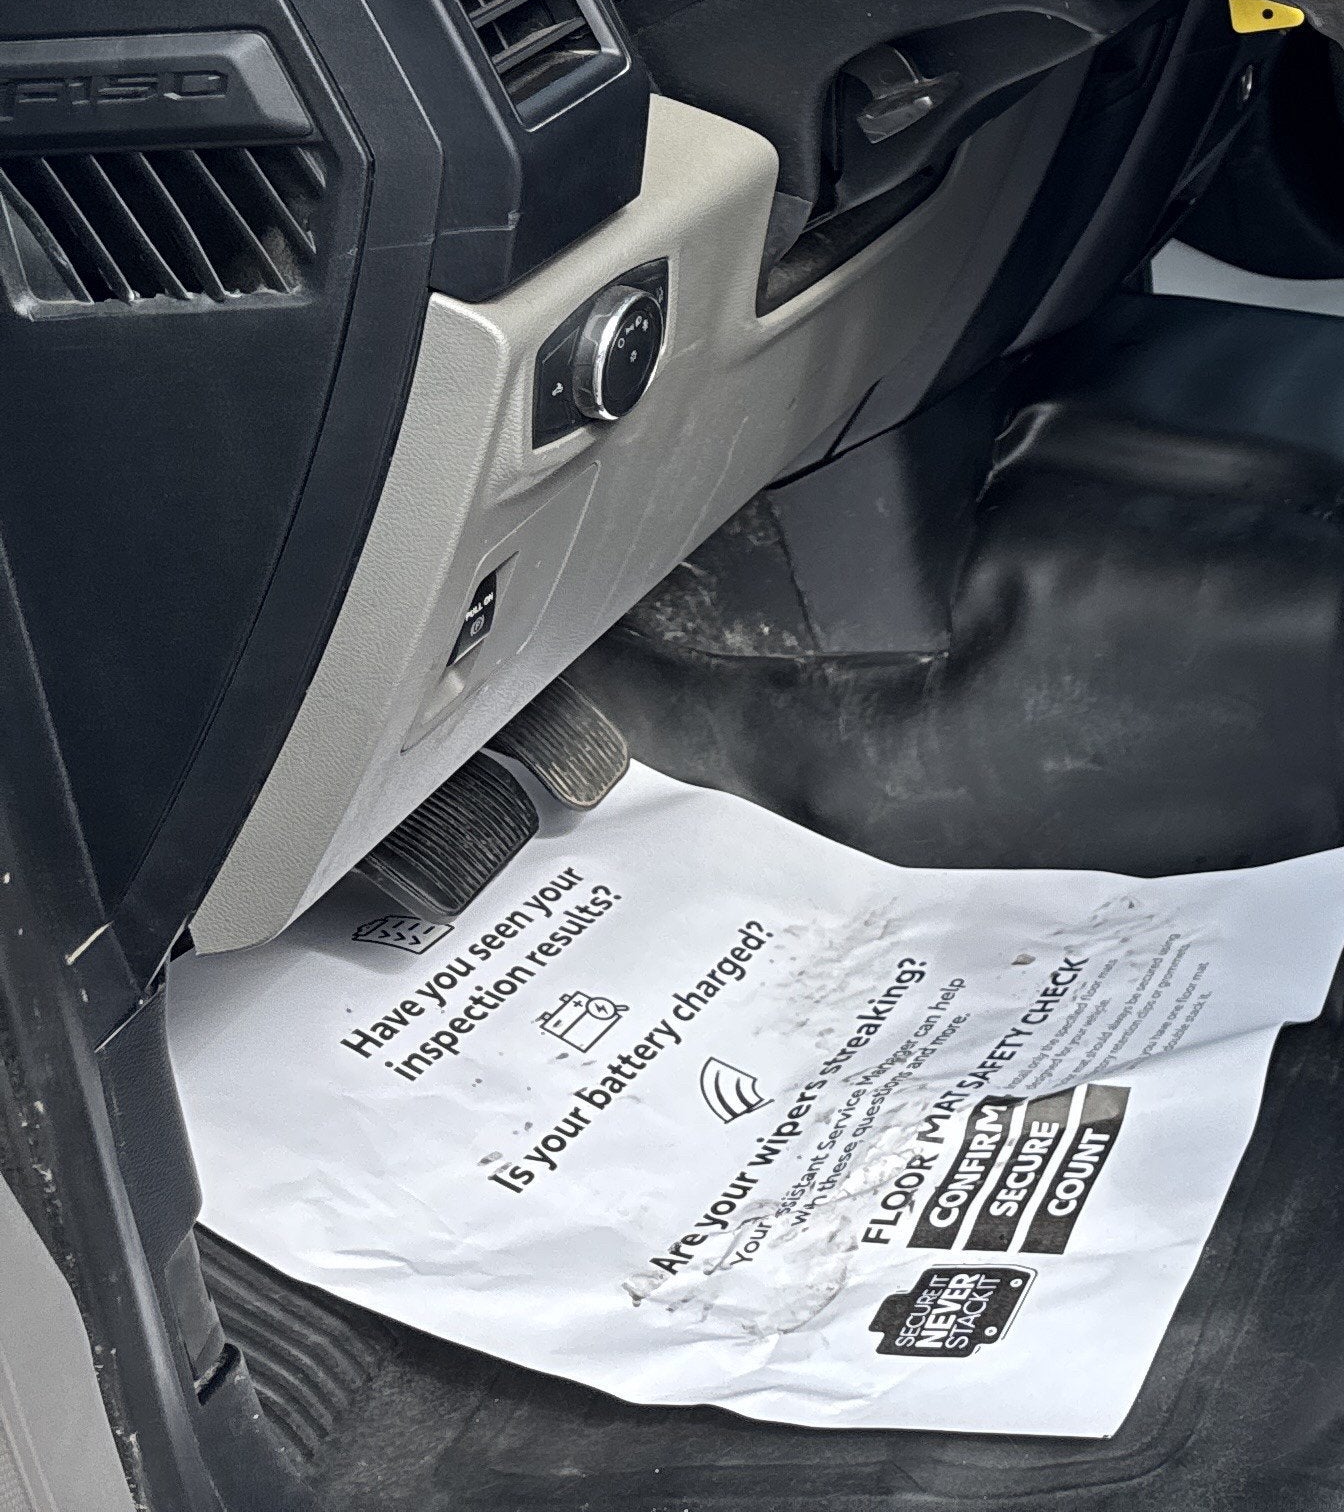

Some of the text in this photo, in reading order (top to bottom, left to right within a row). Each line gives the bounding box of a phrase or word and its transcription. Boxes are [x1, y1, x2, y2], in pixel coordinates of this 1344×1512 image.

[340, 867, 584, 1059] Have you seen your
[384, 885, 622, 1082] inspection results?
[927, 978, 966, 1011] help
[488, 920, 774, 1194] Is your battery charged?
[914, 1014, 941, 1038] can
[649, 957, 927, 1275] Are your wipers streaking?
[817, 1088, 867, 1151] Service
[818, 1142, 858, 1192] these
[852, 1071, 913, 1138] questions
[906, 1047, 937, 1069] and
[861, 957, 1089, 1244] FLOOR MAT SAFETY CHECK
[775, 1153, 829, 1218] ssistant
[929, 1104, 1007, 1228] CONFIRM
[989, 1120, 1059, 1217] SECURE
[1046, 1127, 1111, 1217] COUNT
[730, 1222, 772, 1266] Your
[895, 1274, 950, 1347] SECURE IT
[915, 1273, 981, 1349] NEVER
[945, 1274, 1001, 1349] STACK IT
